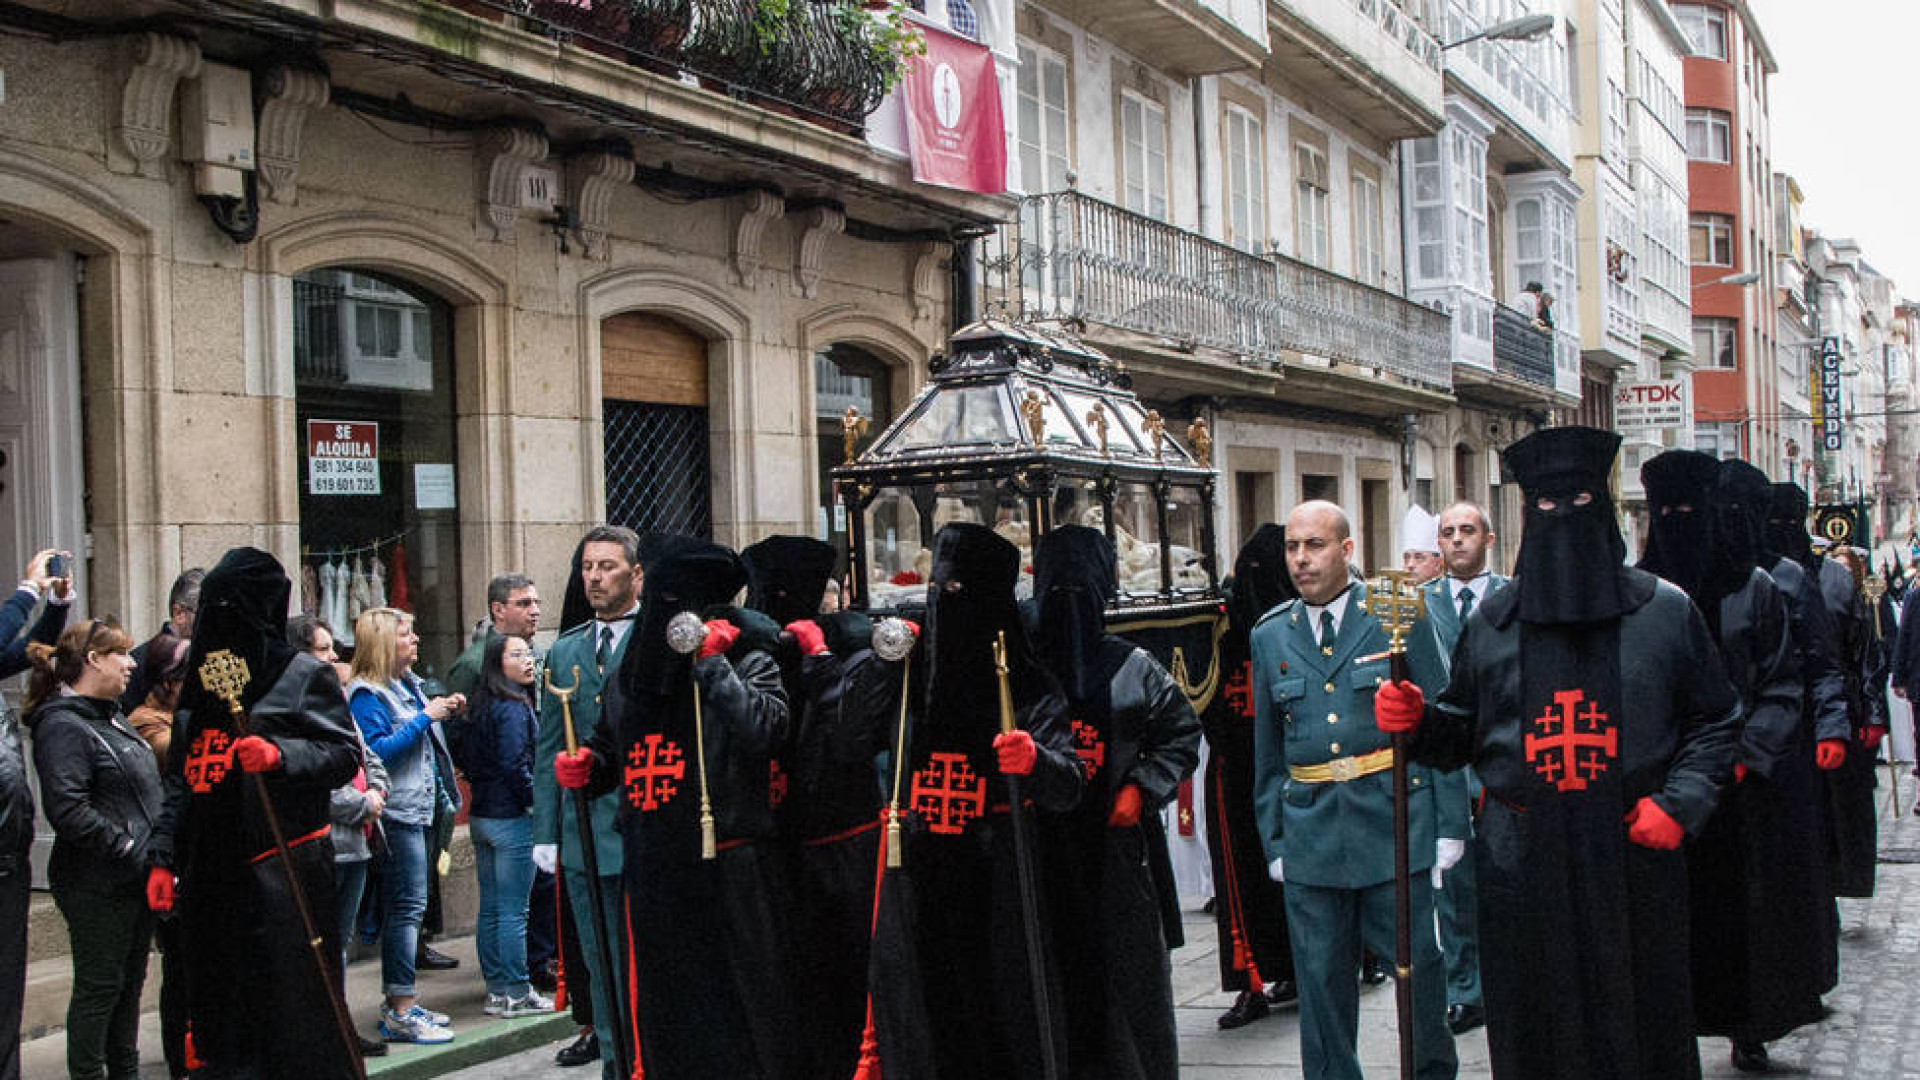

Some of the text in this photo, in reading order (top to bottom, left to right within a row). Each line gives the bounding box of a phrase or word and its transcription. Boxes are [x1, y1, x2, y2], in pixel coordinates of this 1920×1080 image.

[529, 177, 547, 199] 111
[1631, 384, 1681, 403] TDK
[1823, 339, 1840, 447] ACEVEDO
[335, 425, 352, 439] SE
[316, 441, 371, 457] ALQUILA
[314, 460, 333, 472] 981
[336, 460, 353, 472] 354
[316, 478, 375, 490] 619 601 735
